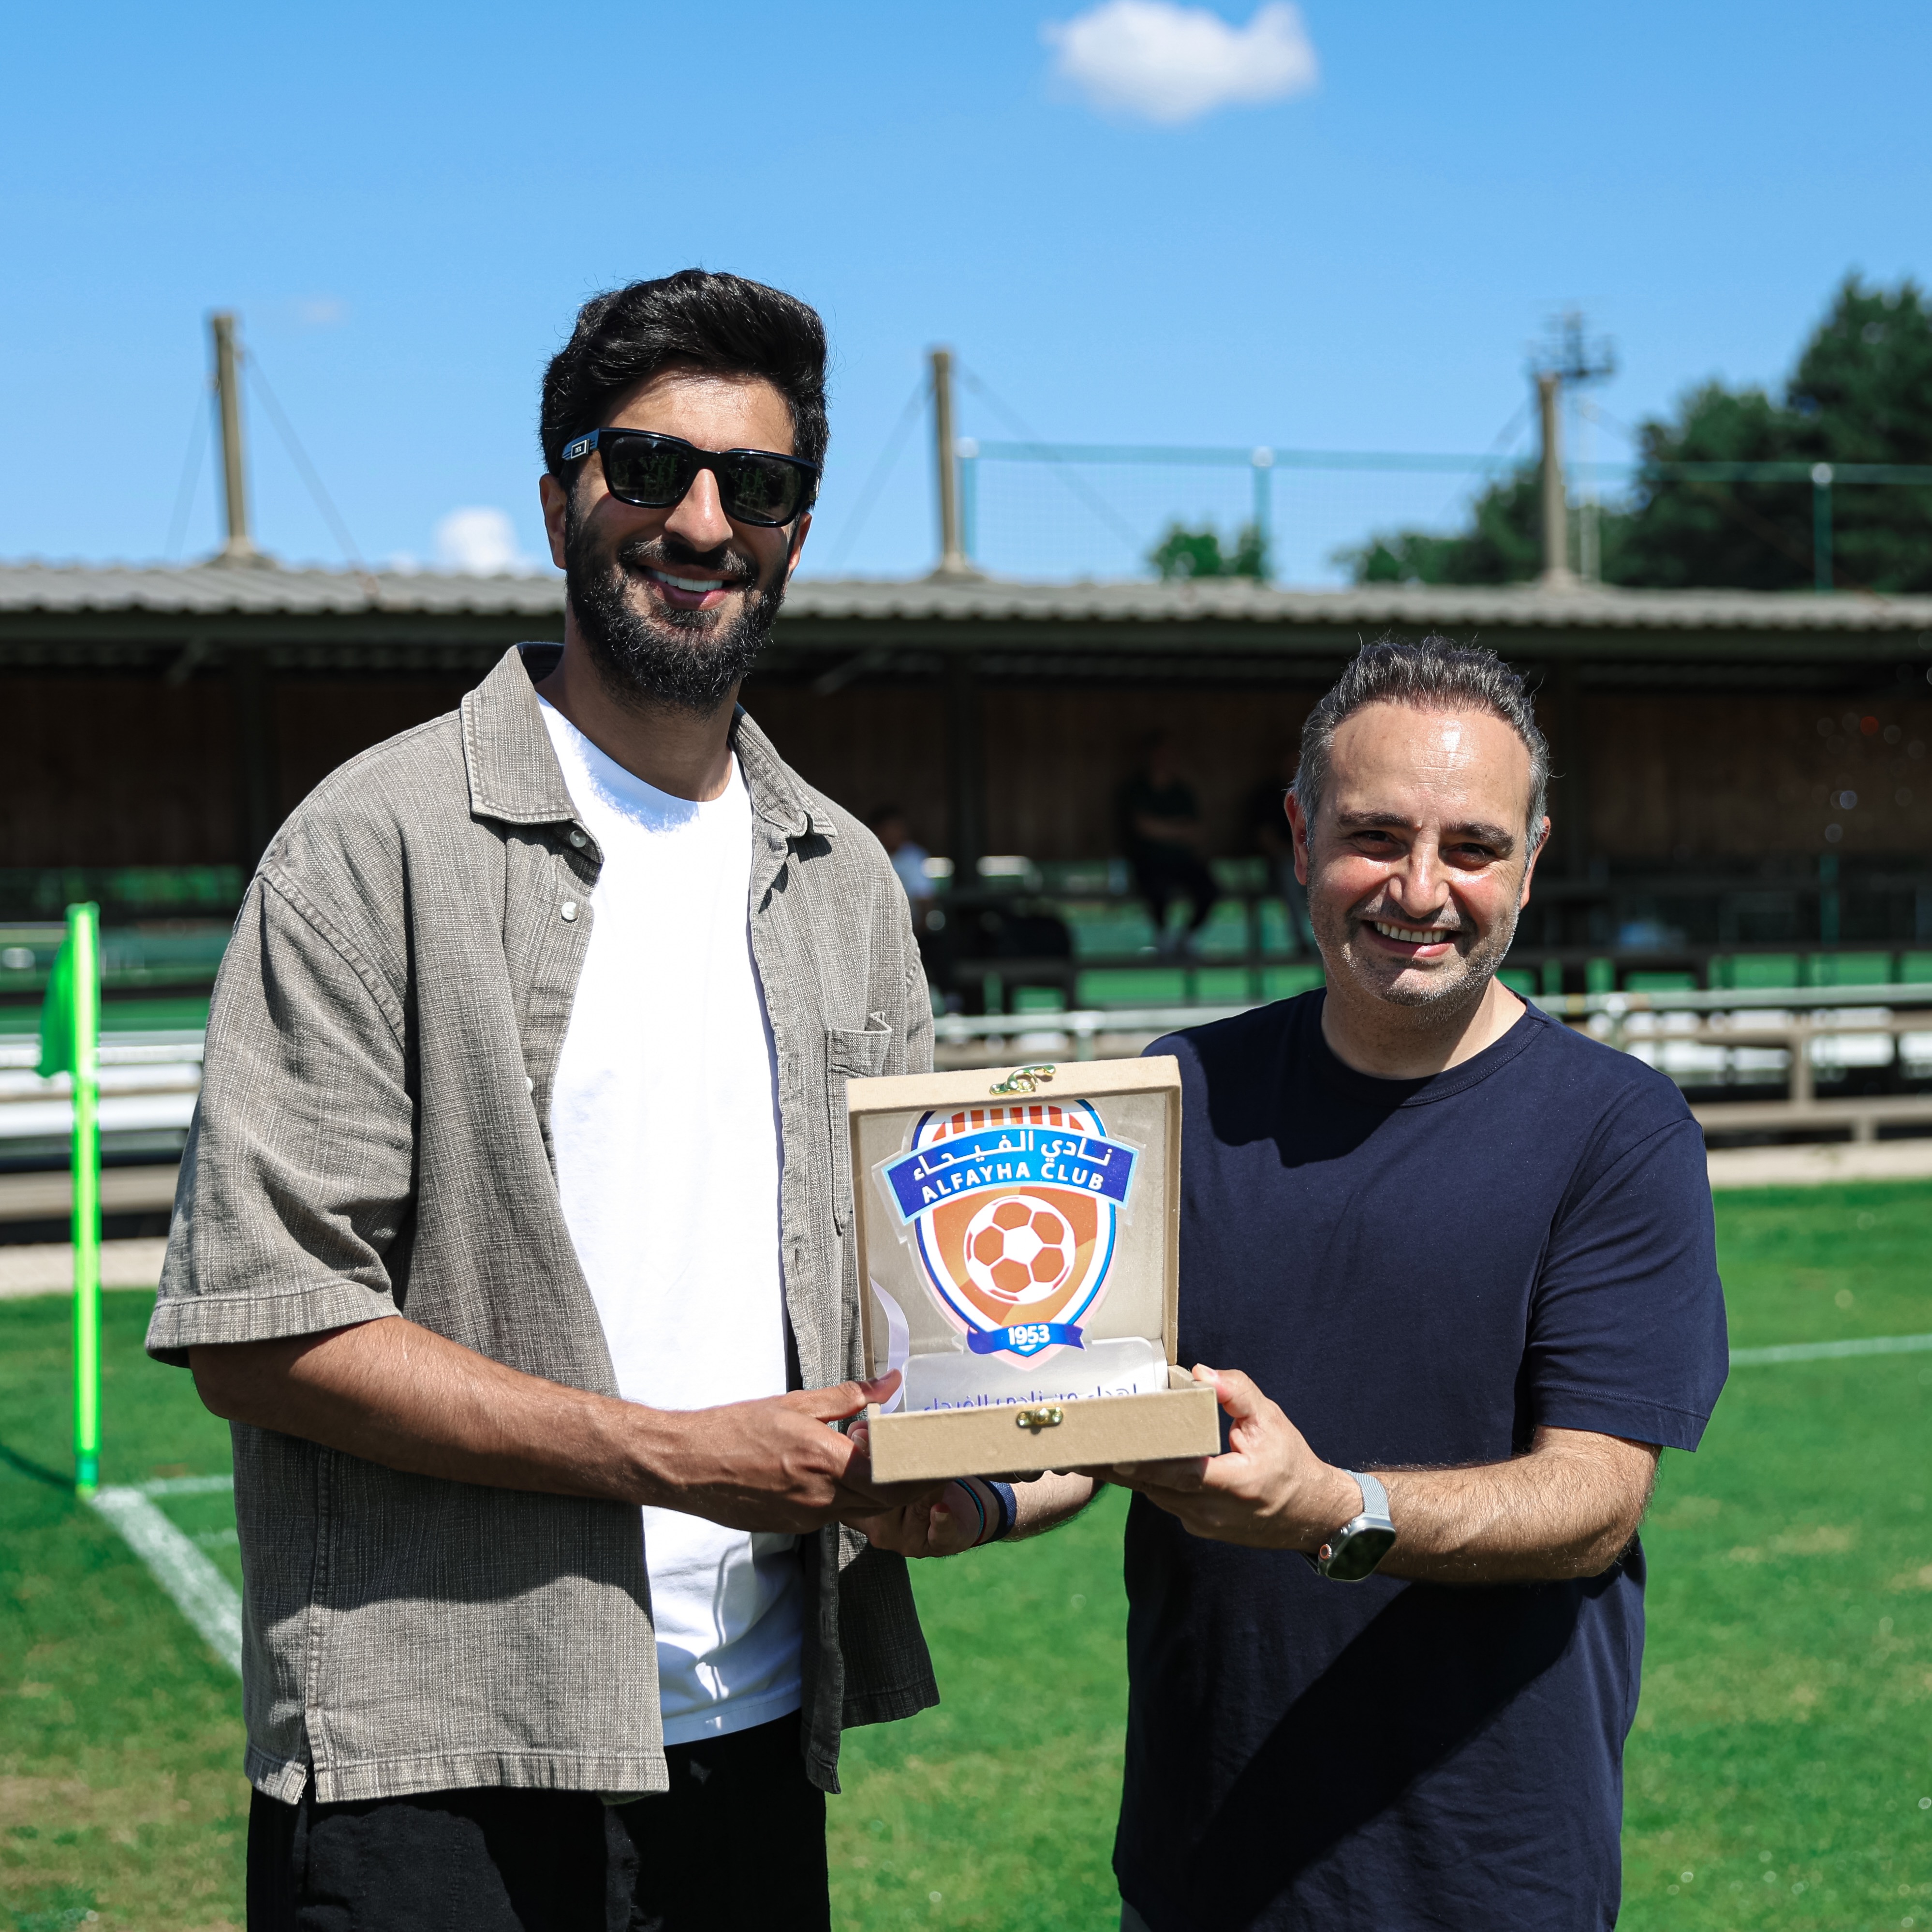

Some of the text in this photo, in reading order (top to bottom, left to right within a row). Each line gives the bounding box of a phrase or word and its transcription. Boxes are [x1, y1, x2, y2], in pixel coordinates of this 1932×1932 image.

[914, 1130, 1113, 1181] نادي الفيحاء
[921, 1162, 1104, 1204] ALFAYHA CLUB
[1008, 1324, 1050, 1345] 1953
